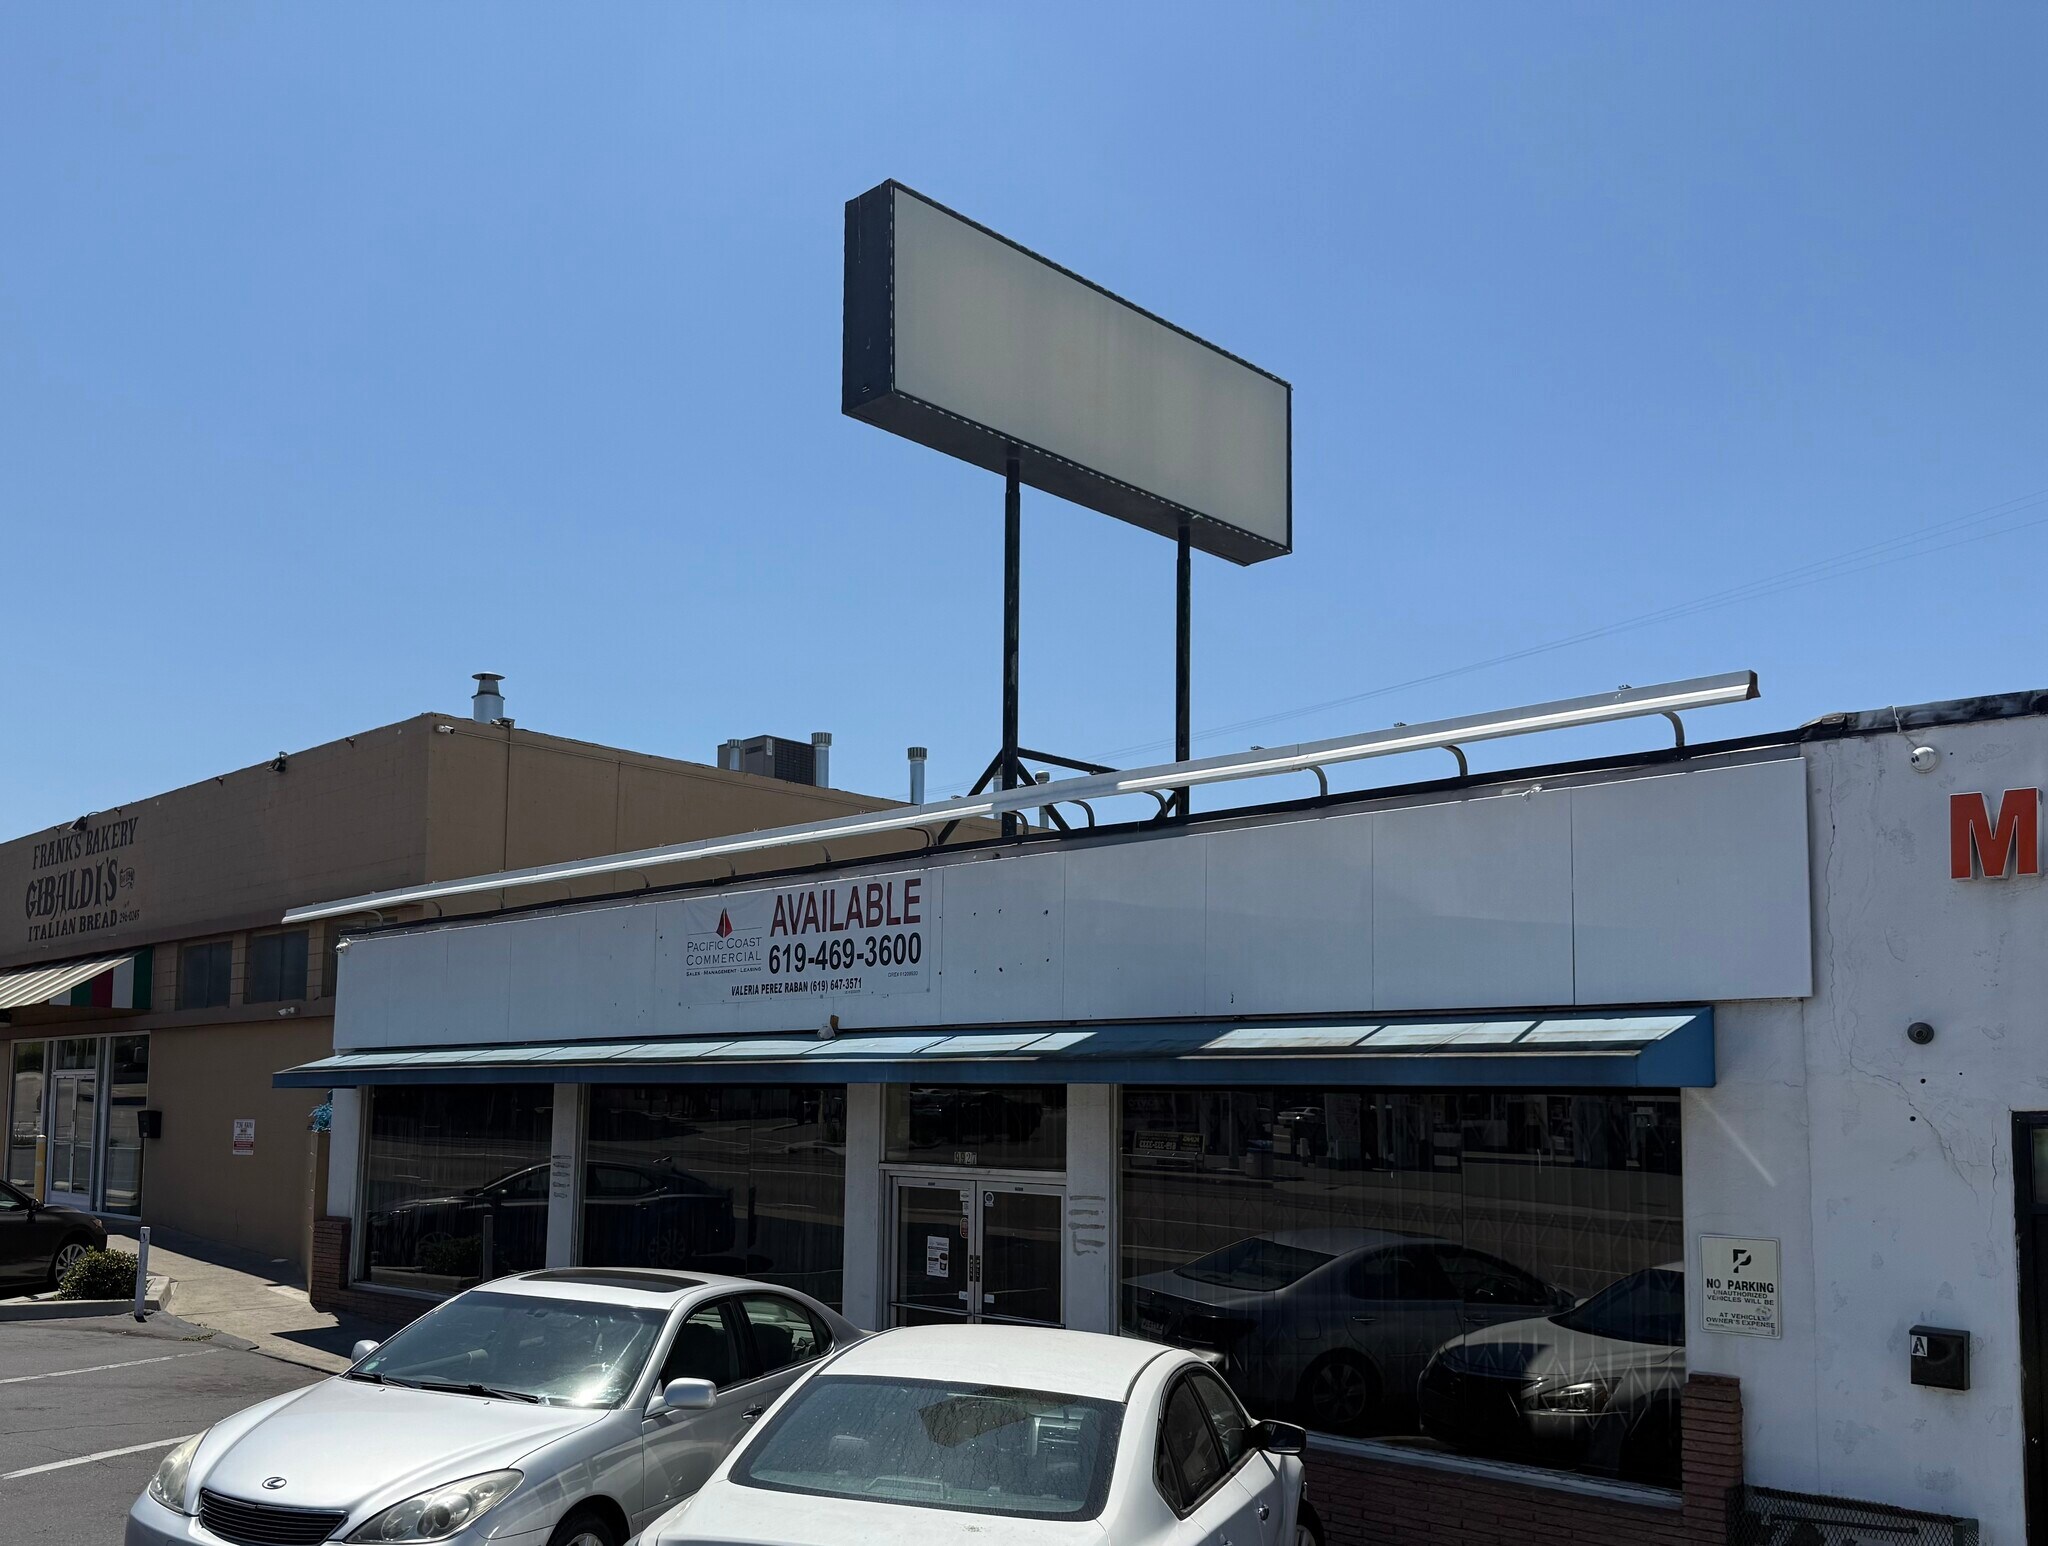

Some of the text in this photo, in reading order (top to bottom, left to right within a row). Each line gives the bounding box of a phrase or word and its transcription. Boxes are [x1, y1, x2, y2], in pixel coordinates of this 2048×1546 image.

[33, 817, 139, 870] FRANK'S BAKERY
[1950, 787, 2043, 880] M
[25, 856, 118, 920] GIBALDI'S
[769, 878, 922, 938] AVAILABLE
[28, 909, 118, 942] ITALIAN BREAD
[686, 936, 763, 953] PACIFIC COAST
[768, 932, 922, 974] 619-469-3600
[686, 950, 762, 967] COMMERCIAL
[731, 976, 863, 997] VALERIA PEREZ RABAN (619) 647-3571
[1706, 1278, 1774, 1294] NO PARKING
[1713, 1289, 1768, 1299] UNAUTHORIZED
[1706, 1294, 1742, 1304] VEHICLES
[1743, 1297, 1762, 1305] WILL
[1705, 1316, 1741, 1325] OWNER'S
[1741, 1319, 1776, 1330] EXPENSE
[1912, 1336, 1927, 1356] A
